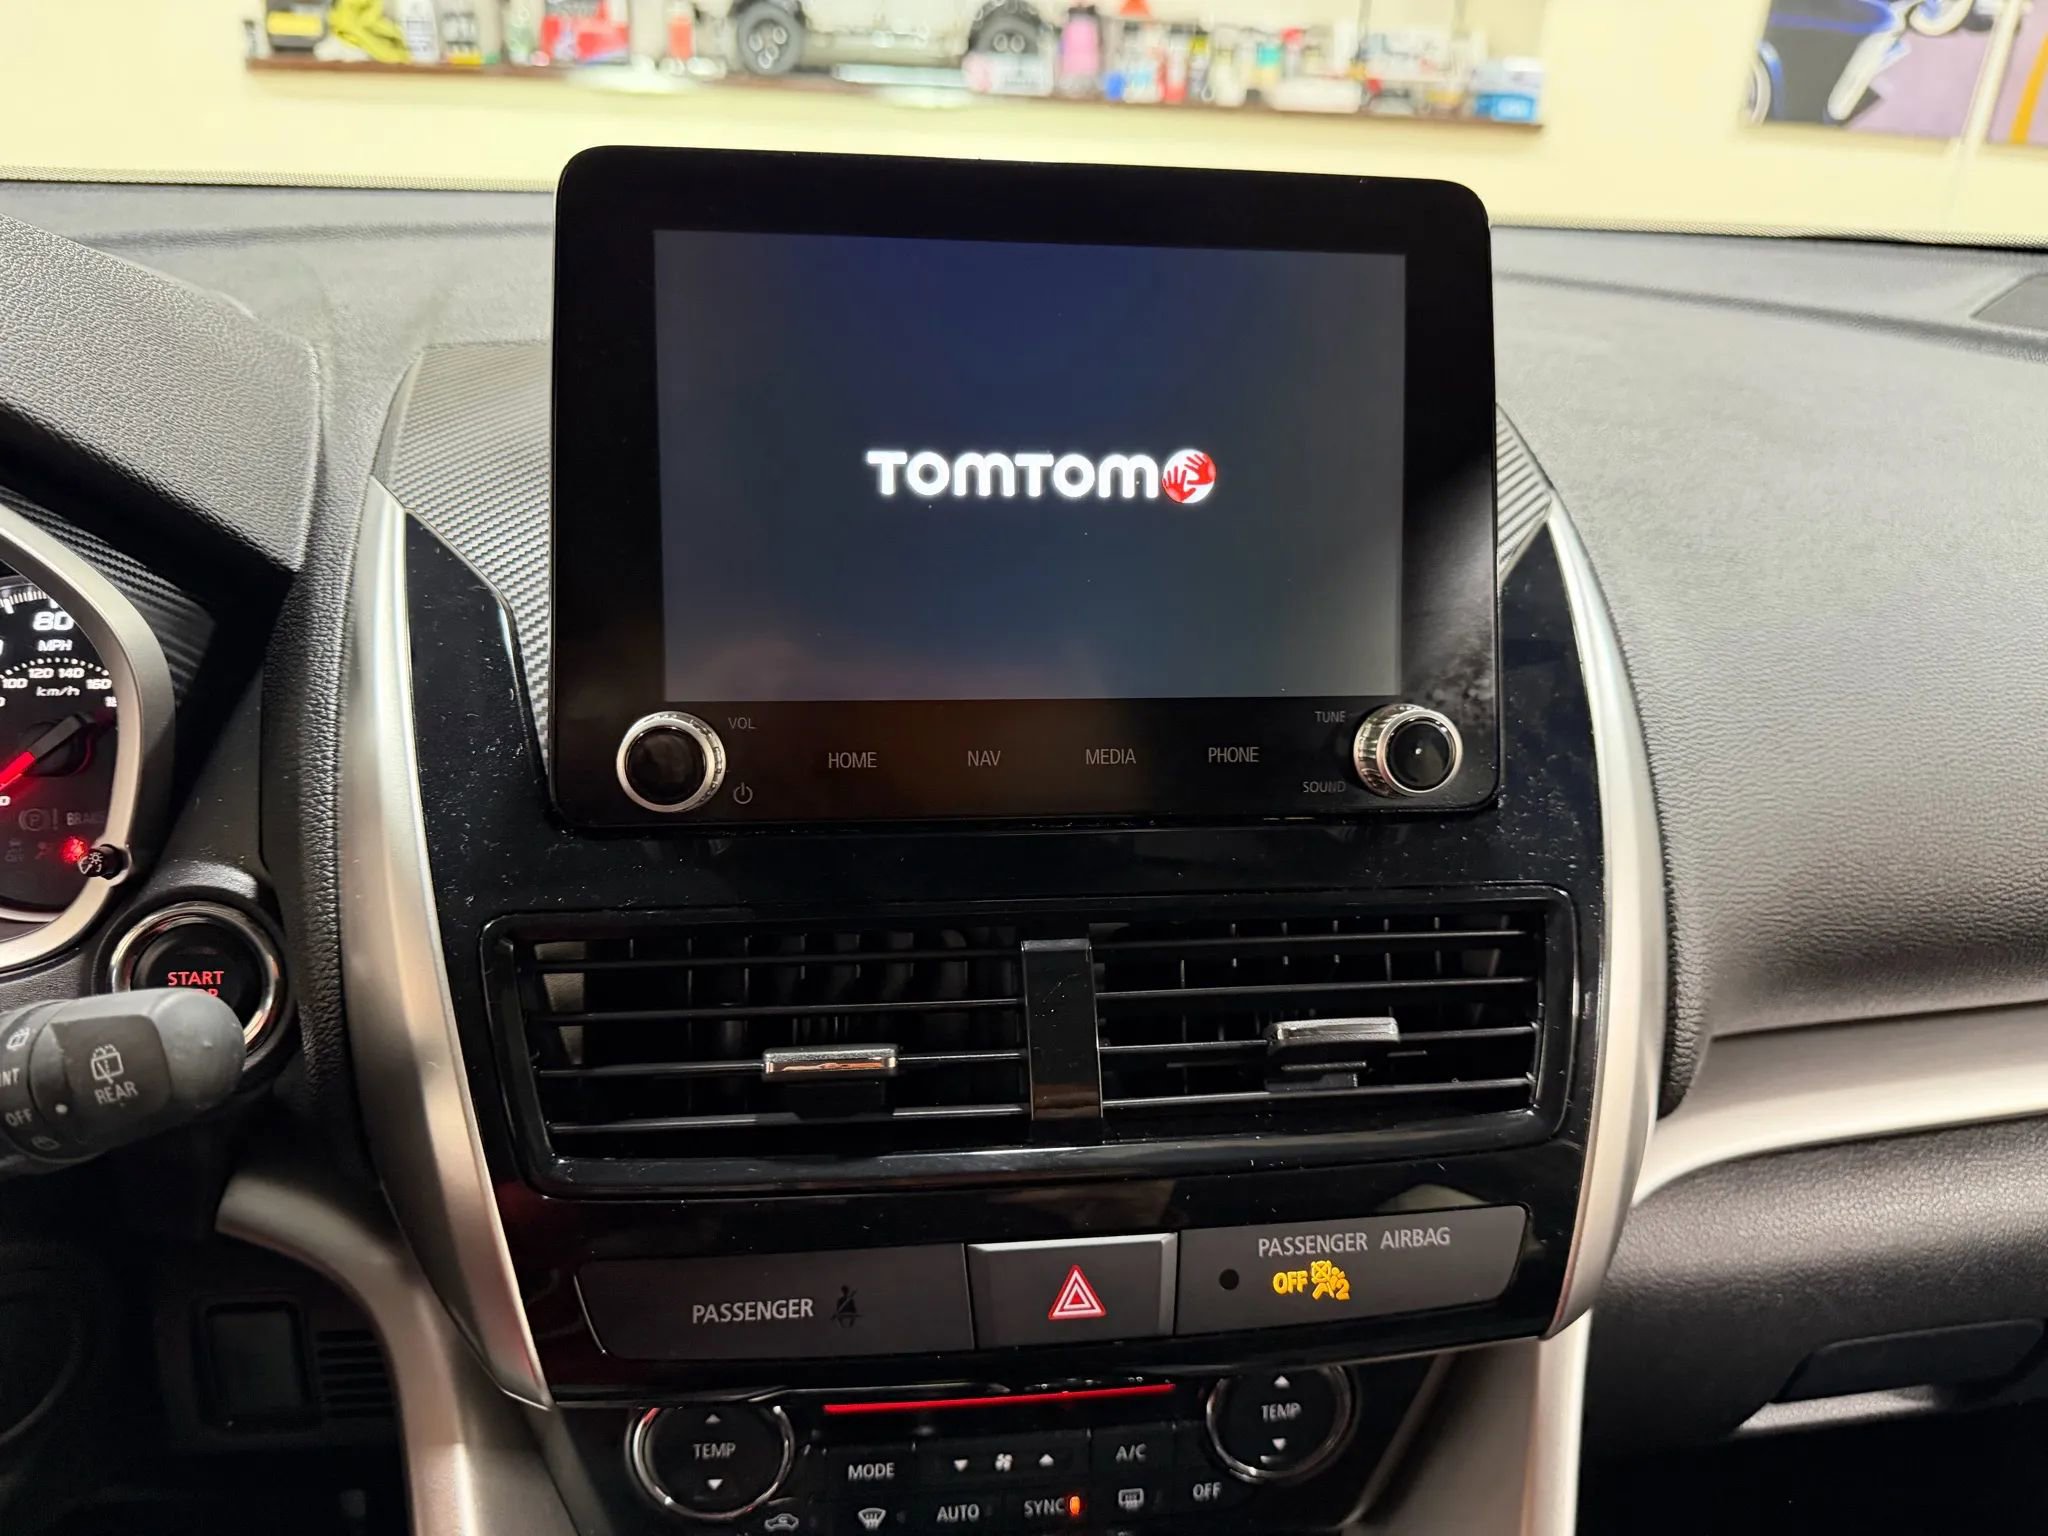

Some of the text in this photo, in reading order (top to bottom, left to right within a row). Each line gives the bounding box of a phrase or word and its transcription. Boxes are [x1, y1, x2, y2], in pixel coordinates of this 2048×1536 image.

[33, 610, 74, 631] 80
[37, 639, 73, 652] MPH
[28, 667, 85, 679] 120 140
[2, 678, 28, 689] 100
[36, 686, 80, 697] km/h
[728, 716, 756, 730] VOL
[1315, 711, 1346, 723] TUNE
[828, 752, 878, 769] HOME
[967, 750, 1001, 767] NAV
[1085, 748, 1137, 765] MEDIA
[1208, 746, 1259, 763] PHONE
[1303, 780, 1346, 794] SOUND
[168, 971, 224, 986] START
[94, 1081, 138, 1105] REAR
[5, 1108, 32, 1127] OFF
[1258, 1226, 1451, 1257] PASSENGER AIRBAG
[1272, 1270, 1309, 1295] OFF
[691, 1297, 814, 1325] PASSENGER
[1261, 1402, 1301, 1420] TEMP
[694, 1442, 736, 1459] TEMP
[1115, 1443, 1147, 1462] A/C
[847, 1462, 895, 1481] MODE
[1192, 1481, 1221, 1501] OFF
[936, 1503, 980, 1523] AUTO
[1023, 1498, 1065, 1518] SYNC
